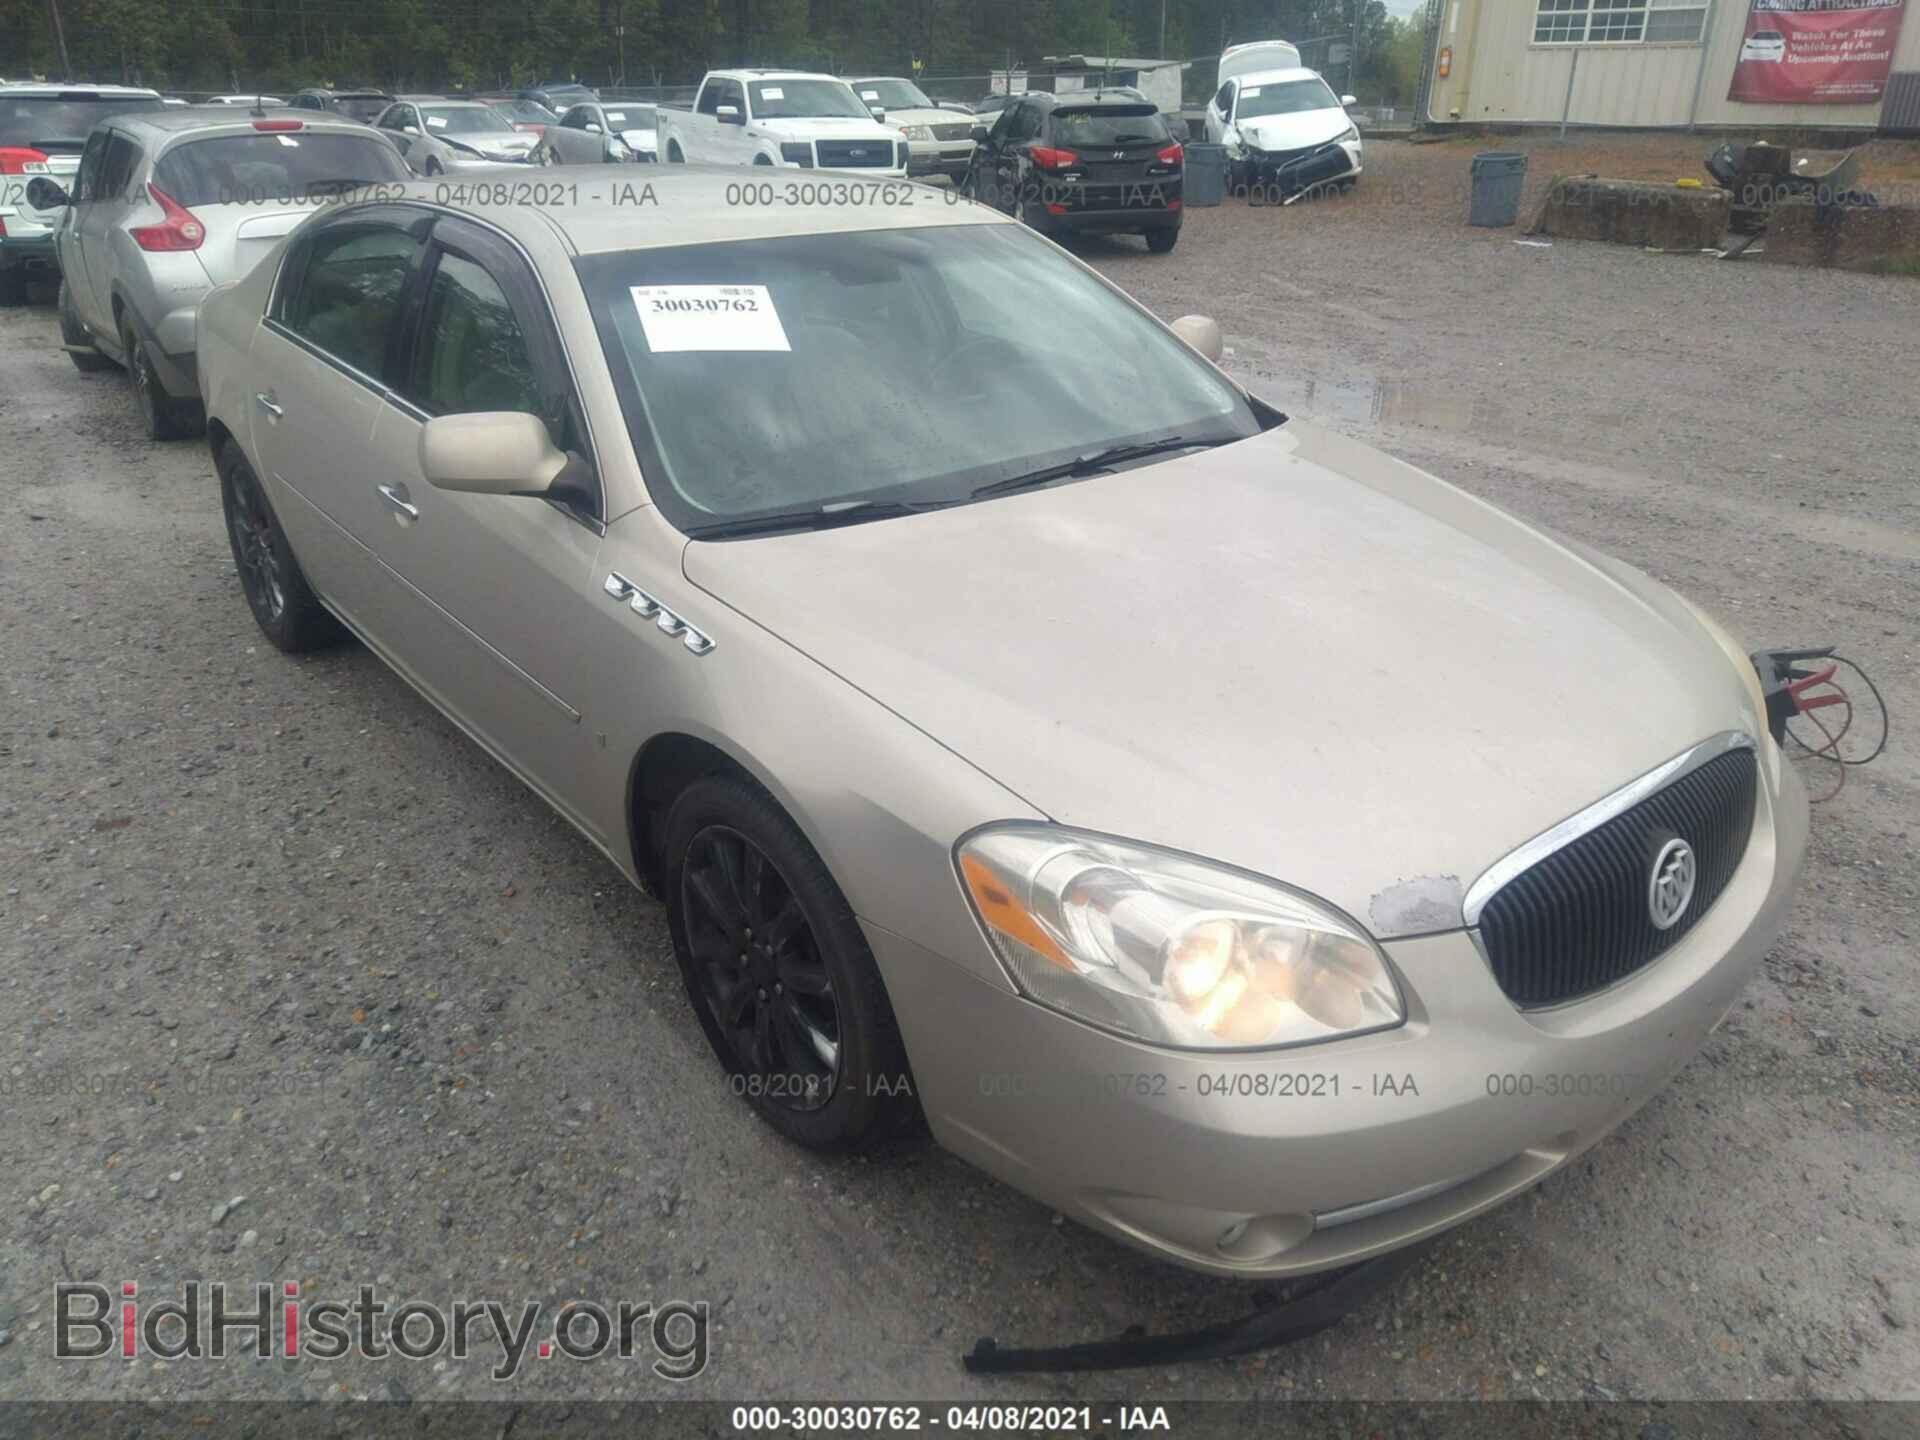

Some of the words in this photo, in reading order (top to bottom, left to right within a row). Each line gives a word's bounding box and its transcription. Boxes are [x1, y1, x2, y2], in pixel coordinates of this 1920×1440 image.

[1792, 31, 1825, 40] Watch
[1829, 30, 1850, 40] For
[1854, 28, 1886, 39] These
[1791, 42, 1838, 51] Vehicles
[1840, 41, 1854, 50] At
[1855, 40, 1873, 49] An
[1788, 53, 1840, 64] Upcoming
[1840, 51, 1889, 62] Auction!
[652, 298, 760, 313] 30030762
